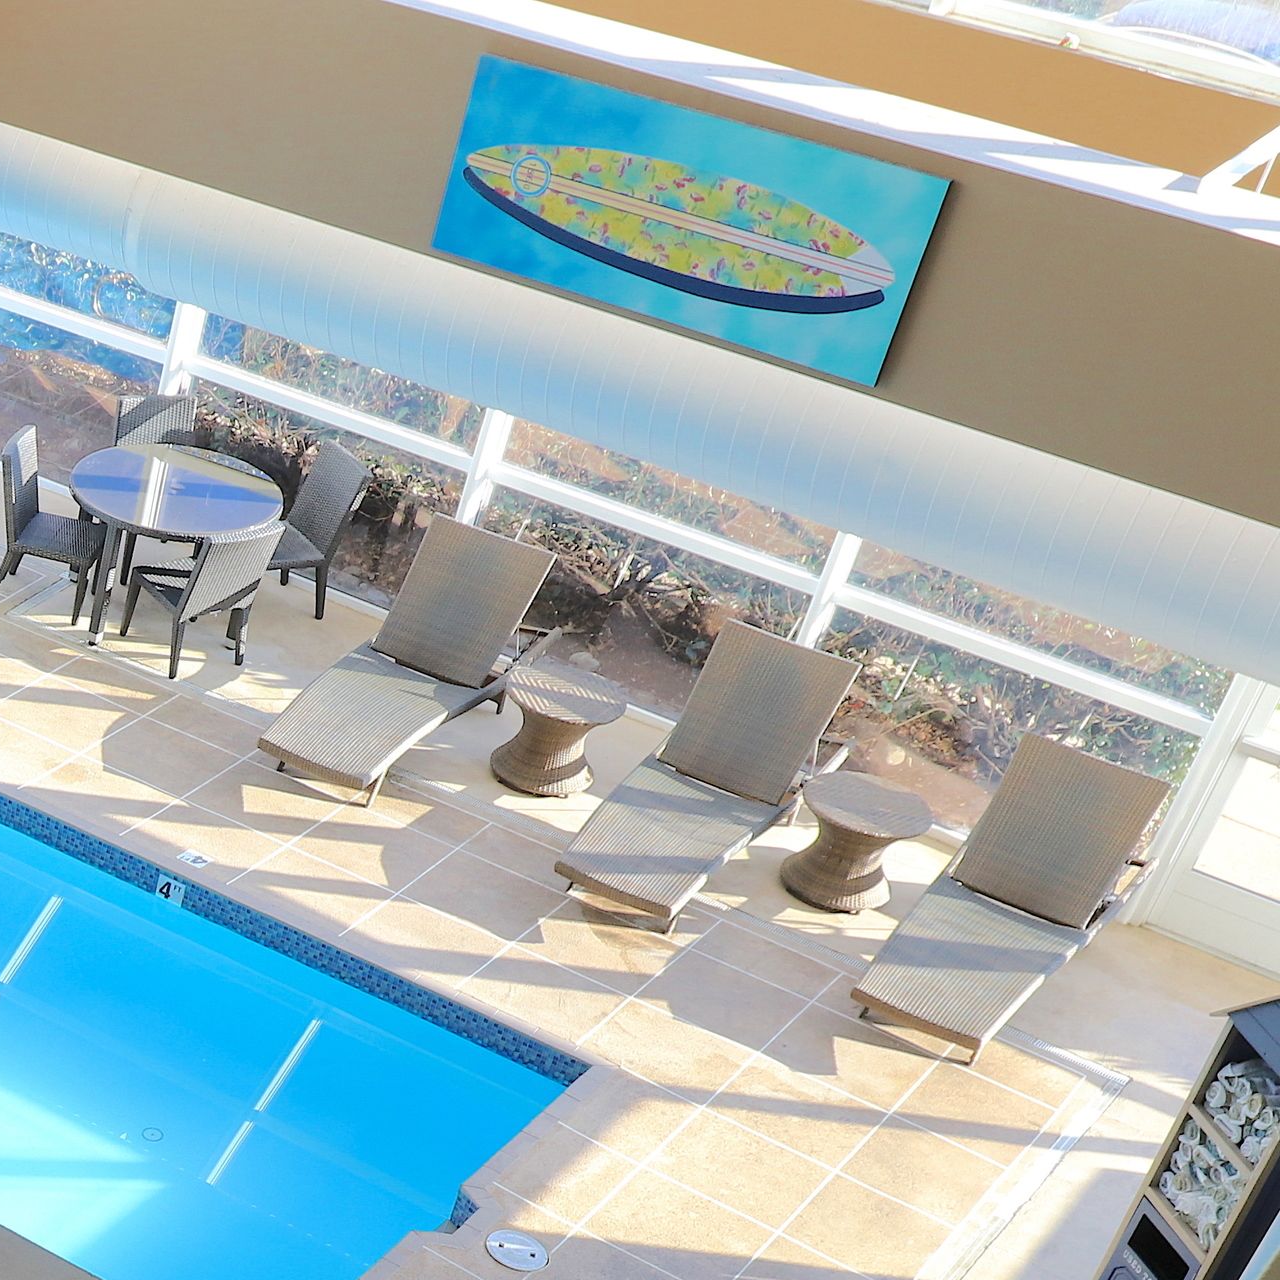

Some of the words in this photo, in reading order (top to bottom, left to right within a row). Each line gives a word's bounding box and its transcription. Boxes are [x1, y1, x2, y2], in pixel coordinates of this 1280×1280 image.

[159, 881, 171, 899] 4
[173, 885, 182, 893] FT
[1123, 1249, 1142, 1274] USED
